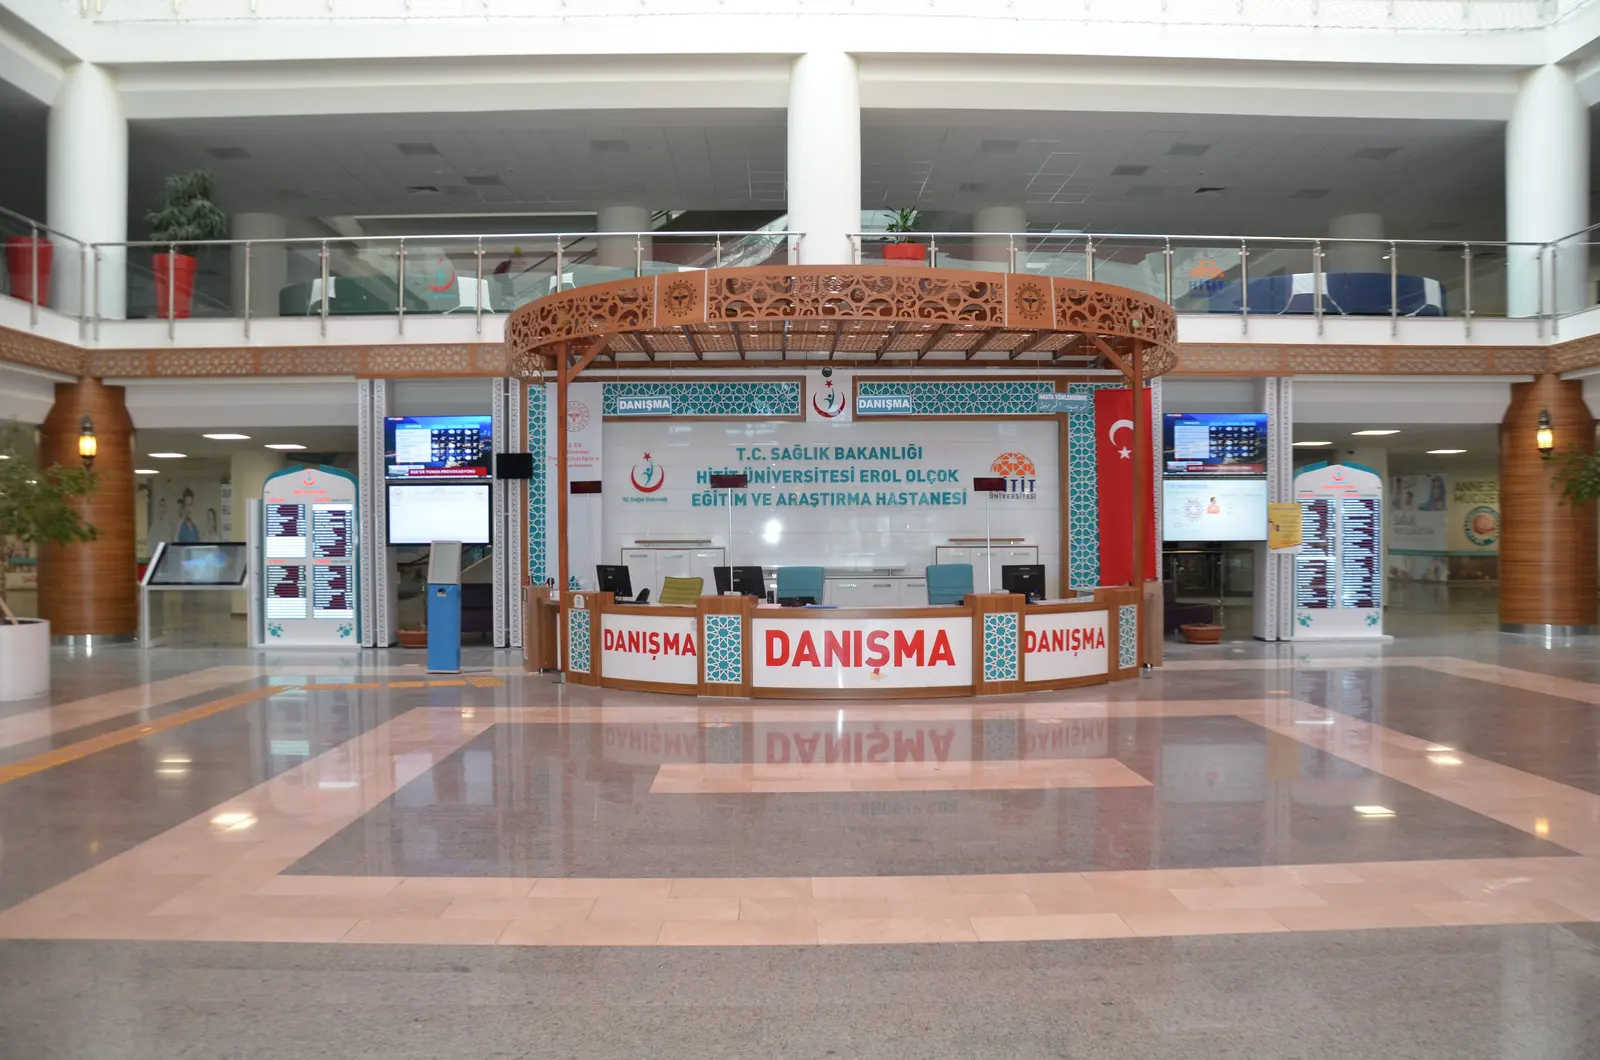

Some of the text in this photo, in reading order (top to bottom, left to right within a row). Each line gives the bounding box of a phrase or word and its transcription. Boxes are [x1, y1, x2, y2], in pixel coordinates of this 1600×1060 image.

[619, 399, 670, 411] DANIŞMA
[859, 399, 910, 411] DANIŞMA
[736, 443, 923, 461] T.C. SAĞLIK BAKANLIĞI
[743, 466, 855, 484] ÜNİVERSİTESİ
[860, 469, 902, 484] EROL
[906, 469, 959, 485] OLÇOK
[1003, 476, 1036, 492] İTİT
[691, 488, 967, 508] EĞİTİM VE ARAŞTIRMA HASTANESİ
[989, 491, 1037, 500] ÜNİVERSİTESİ
[604, 628, 697, 660] DANIŞMA
[1024, 627, 1106, 657] DANIŞMA
[765, 629, 956, 674] DANIŞMA
